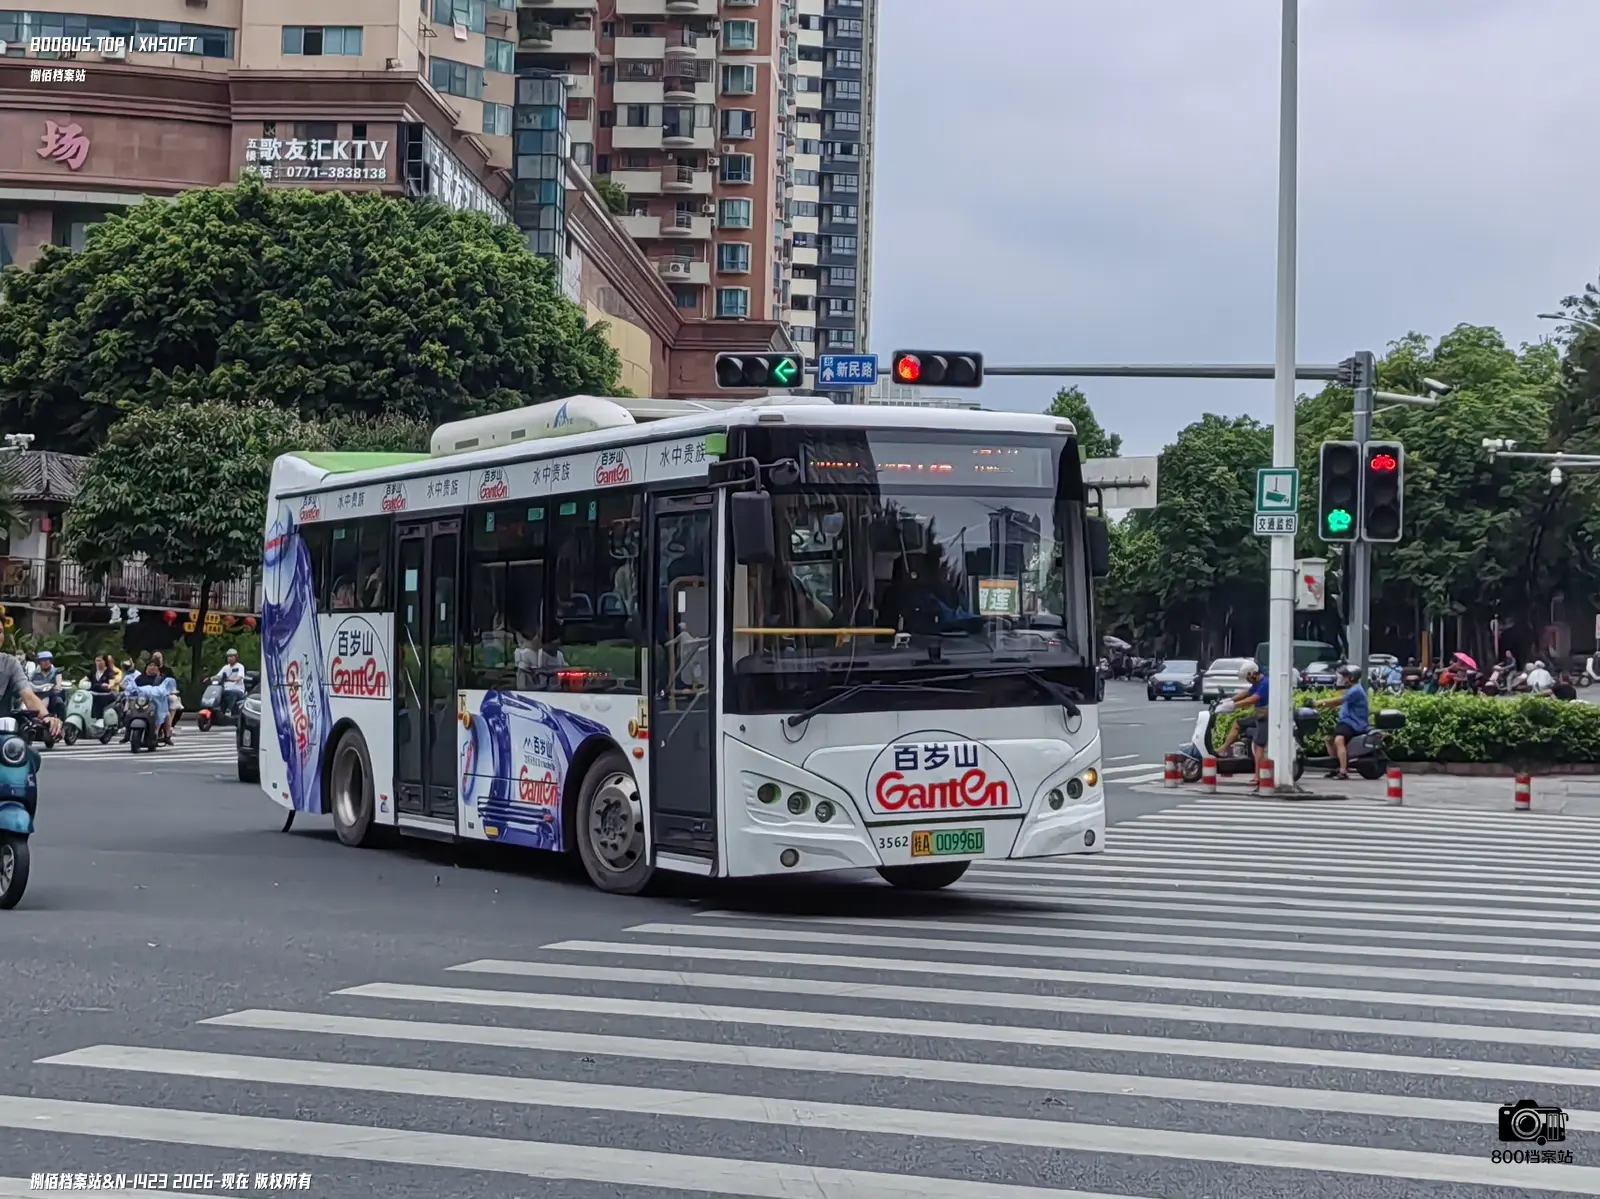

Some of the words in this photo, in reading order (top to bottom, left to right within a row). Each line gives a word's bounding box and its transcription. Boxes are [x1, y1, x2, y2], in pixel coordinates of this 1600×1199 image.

[36, 120, 91, 171] 场
[260, 138, 389, 161] 歌友汇KTV
[286, 166, 387, 179] 0771-3838138
[836, 361, 873, 378] 新民路
[601, 450, 624, 466] 百岁山
[660, 441, 706, 468] 水中贵族
[484, 469, 503, 483] 百岁山
[532, 461, 571, 485] 水中贵族
[427, 479, 459, 499] 水中贵族
[1258, 517, 1294, 531] 交通监控
[338, 629, 374, 657] 百岁山
[638, 708, 648, 728] 上
[533, 735, 553, 759] 百岁山
[893, 743, 979, 771] 百岁山
[879, 836, 909, 849] 3562
